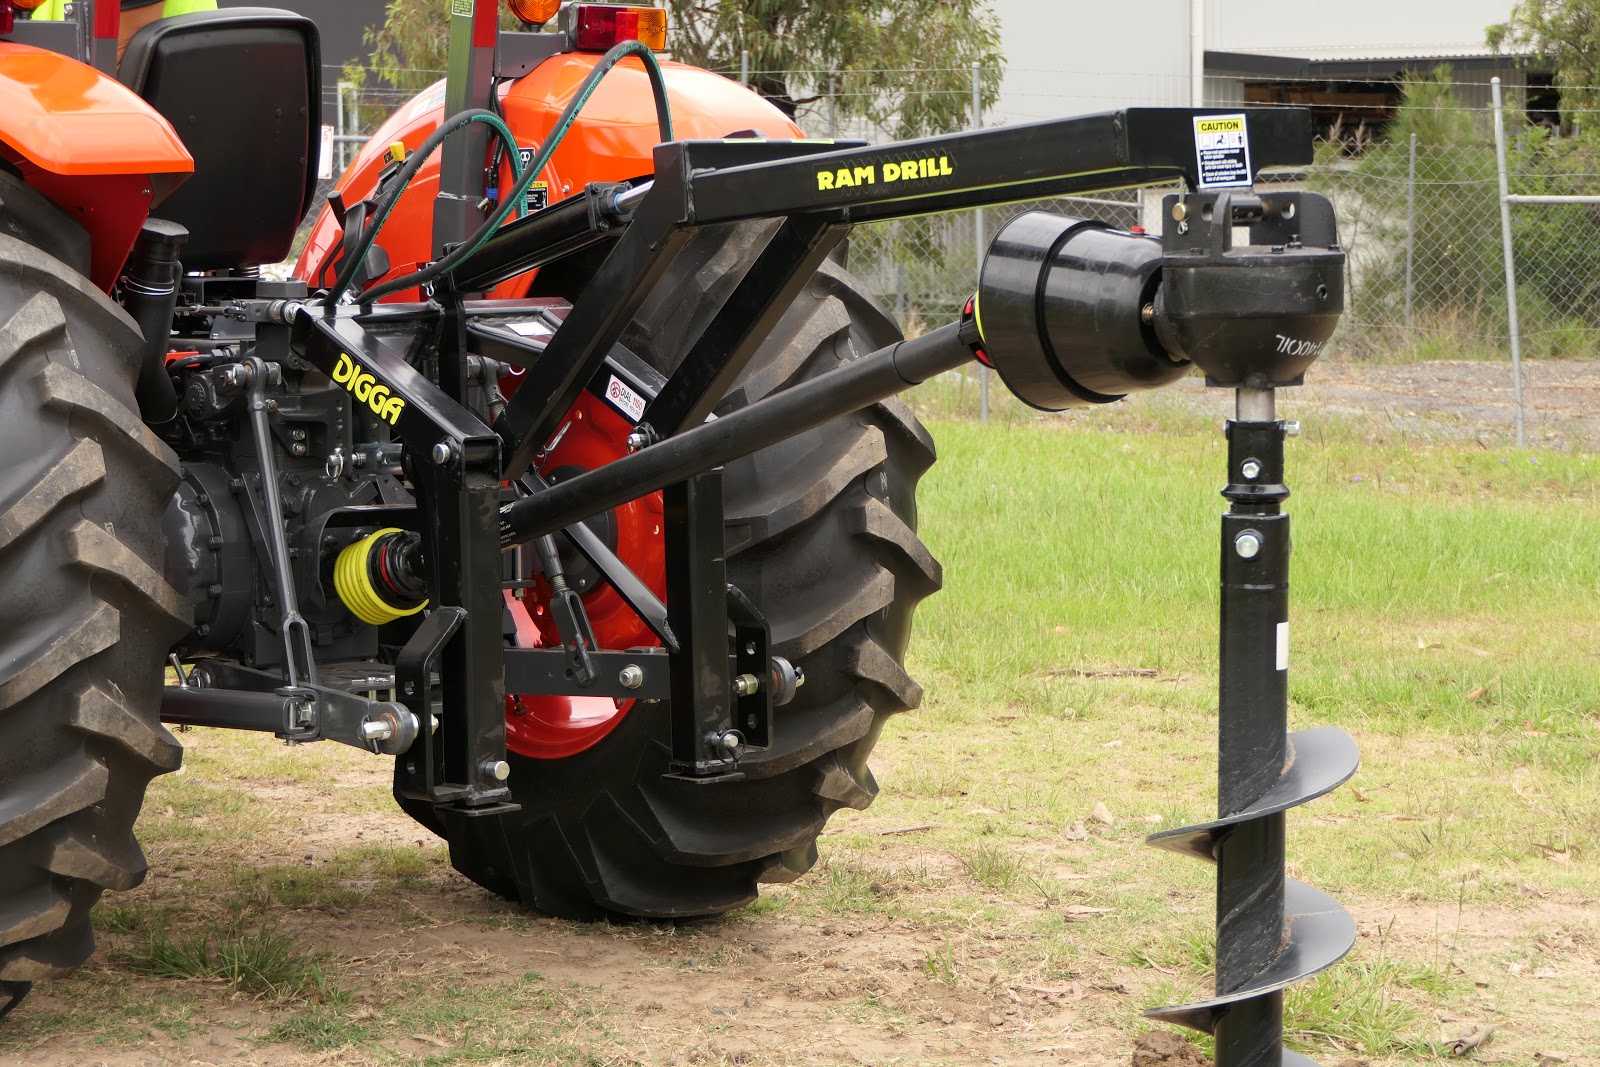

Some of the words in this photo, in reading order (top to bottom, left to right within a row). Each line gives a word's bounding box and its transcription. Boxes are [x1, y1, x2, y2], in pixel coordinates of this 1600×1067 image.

[1201, 121, 1239, 131] CAUTION
[817, 165, 875, 191] RAM
[883, 156, 953, 183] DRILL
[332, 352, 405, 425] DIGGA
[621, 387, 632, 403] DIAL
